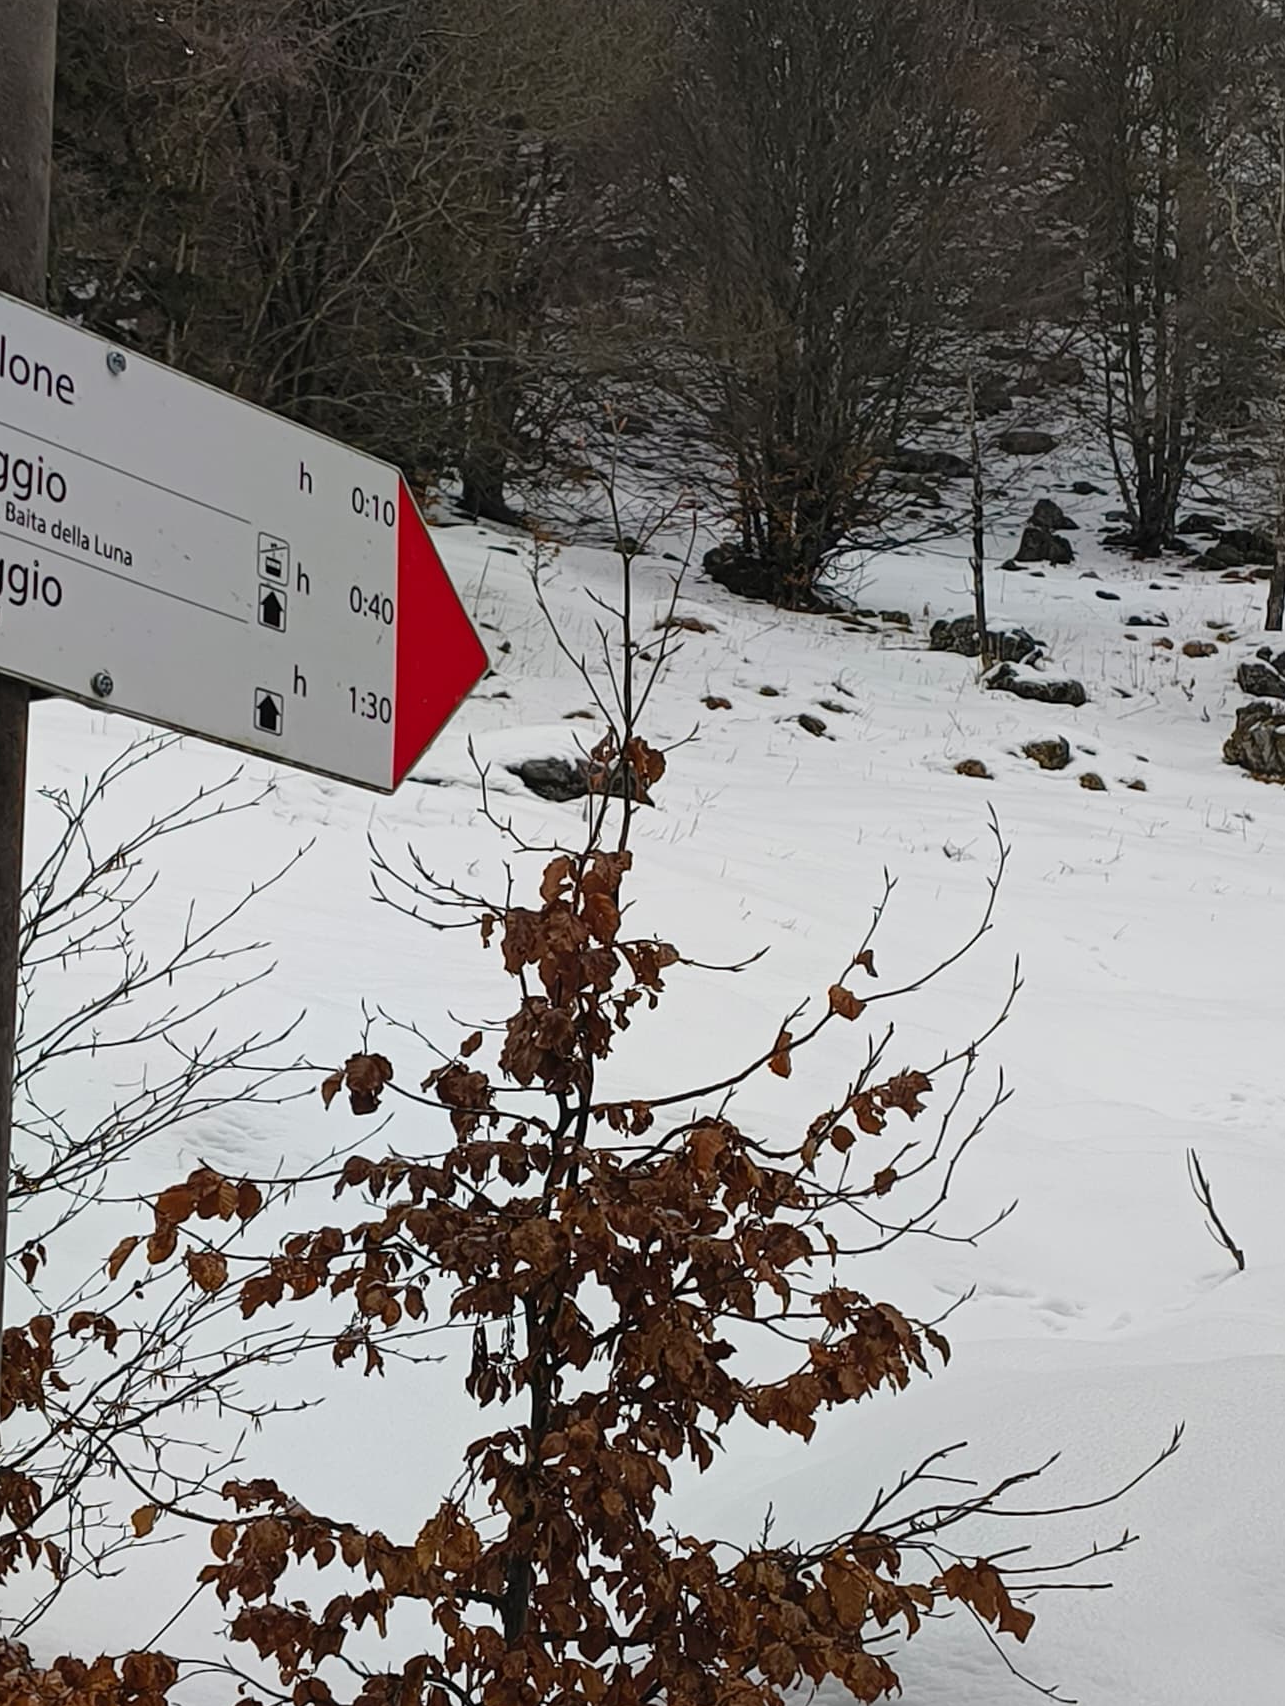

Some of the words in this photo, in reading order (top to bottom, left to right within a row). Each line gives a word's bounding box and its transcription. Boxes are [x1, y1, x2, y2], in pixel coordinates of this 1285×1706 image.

[299, 460, 313, 495] h
[351, 486, 393, 528] 0:10
[5, 500, 47, 535] Baita
[50, 519, 90, 552] della
[94, 533, 133, 567] Luna
[296, 561, 311, 596] h
[349, 584, 392, 626] 0:40
[293, 663, 307, 698] h
[348, 685, 390, 725] 1:30
